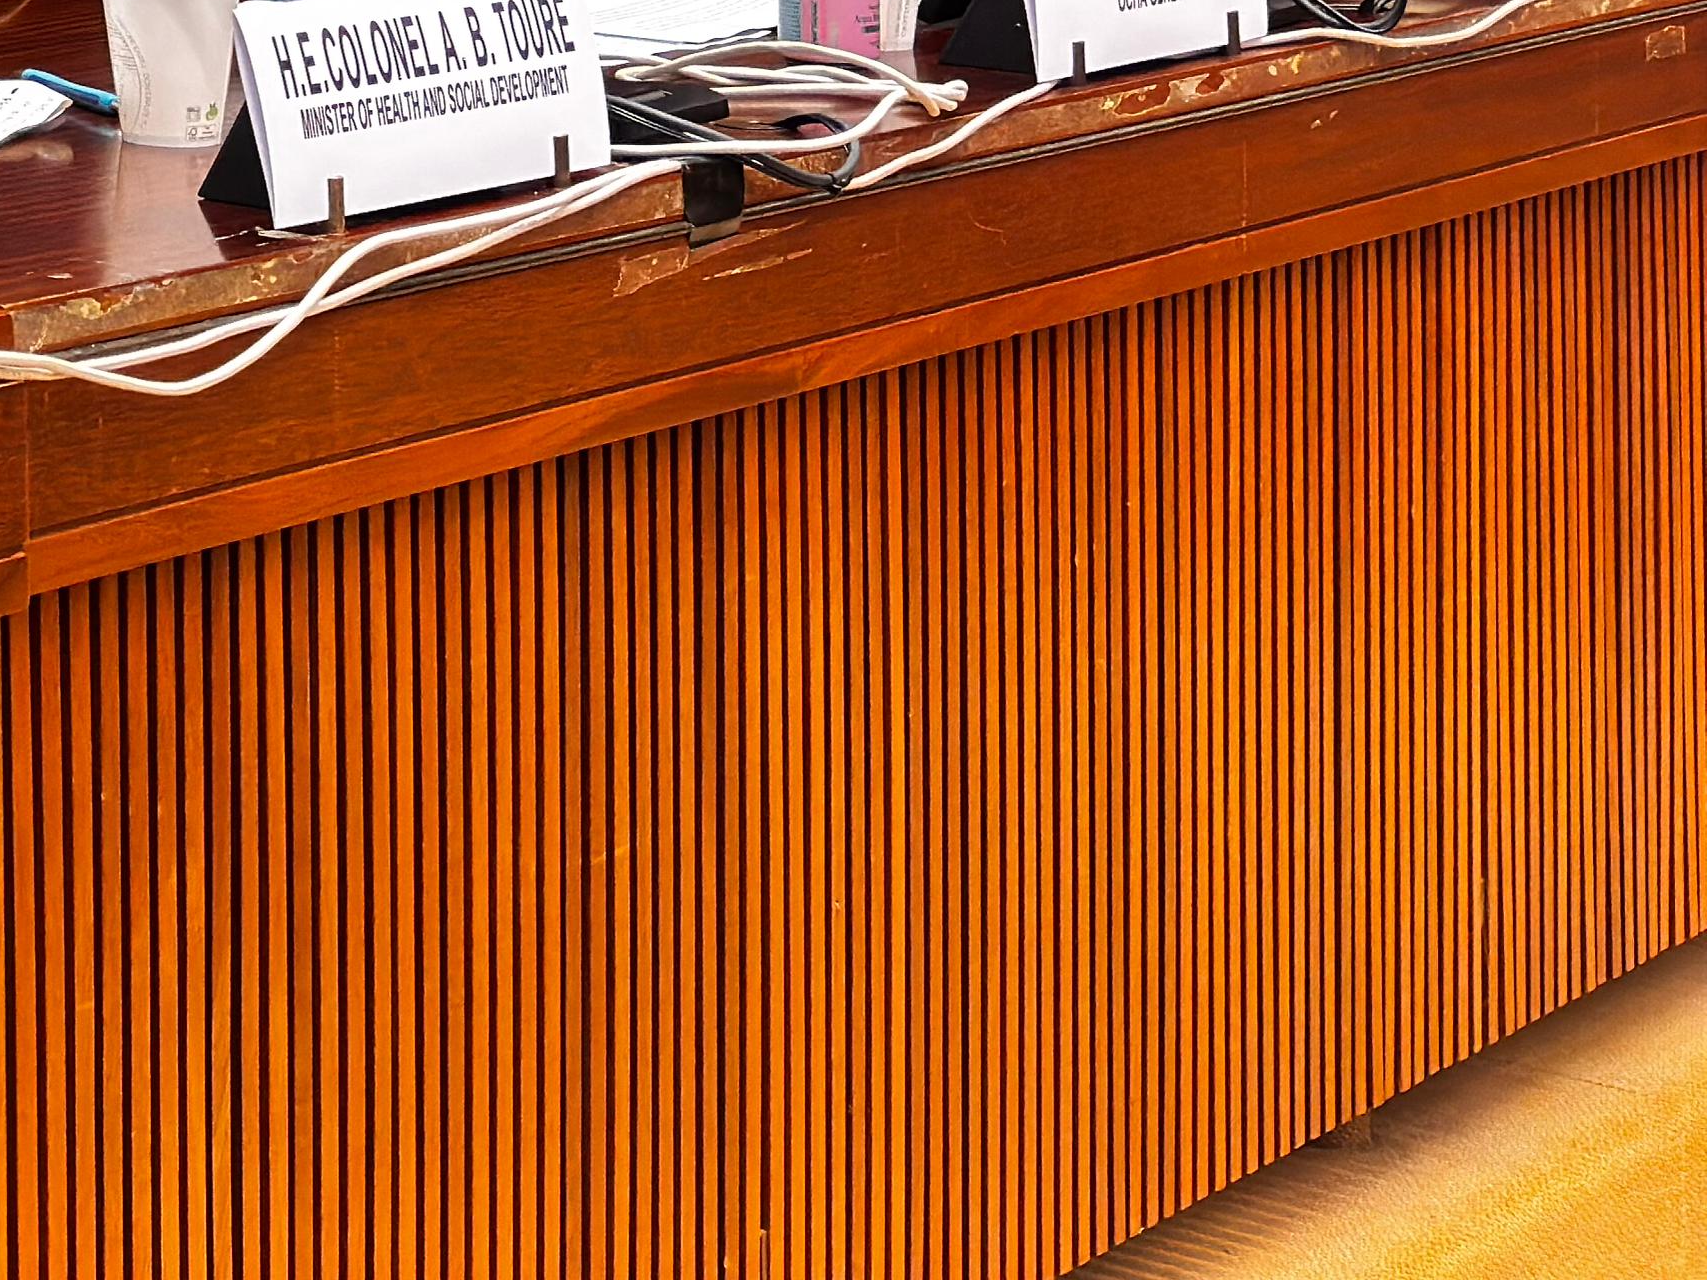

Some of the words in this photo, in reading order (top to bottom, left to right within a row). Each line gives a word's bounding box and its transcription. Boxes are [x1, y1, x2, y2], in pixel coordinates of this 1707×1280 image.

[272, 15, 440, 99] H.E.COLONEL
[438, 10, 467, 73] A.
[464, 6, 496, 67] B.
[300, 100, 358, 139] MINISTER
[357, 98, 374, 130] OF
[376, 90, 422, 126] HEALTH
[423, 86, 447, 117] AND
[448, 78, 490, 114] SOCIAL
[489, 65, 570, 106] DEVELOPMENT
